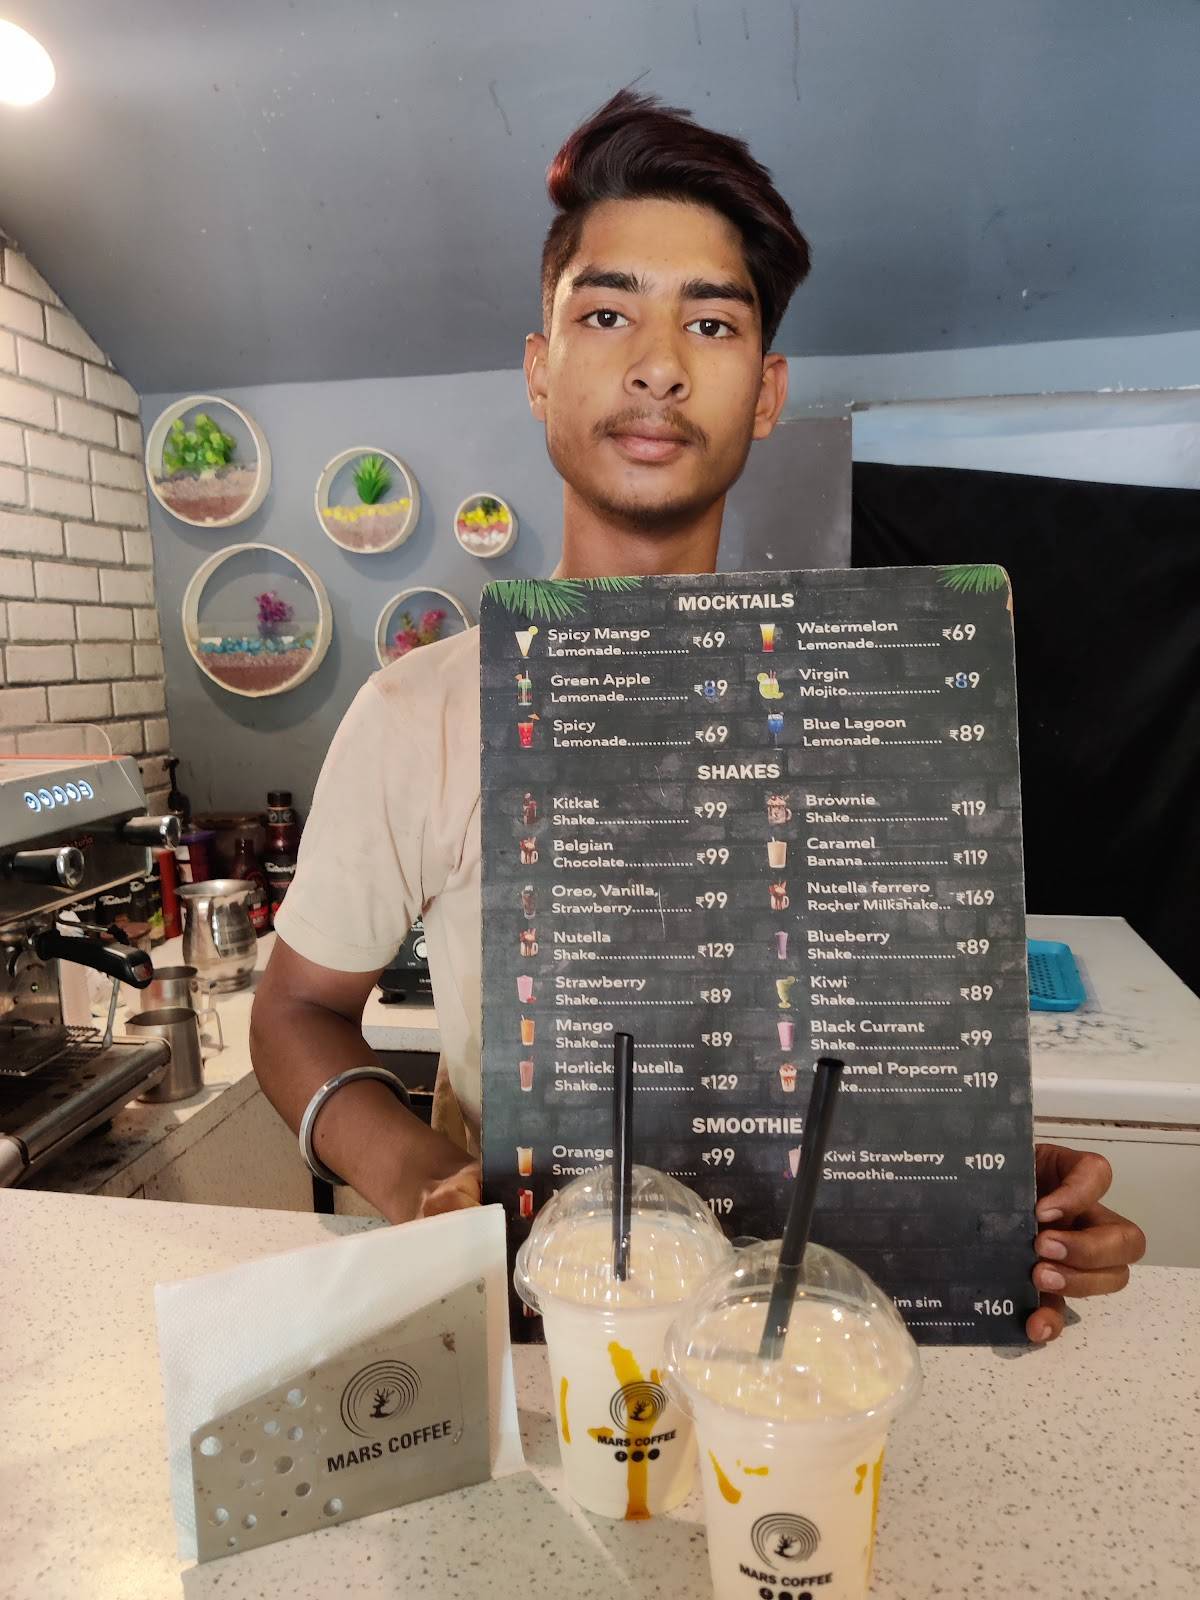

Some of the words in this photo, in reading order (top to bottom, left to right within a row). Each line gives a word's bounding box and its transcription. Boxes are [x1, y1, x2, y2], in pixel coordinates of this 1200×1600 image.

[678, 593, 795, 612] MOCKTAILS
[796, 620, 898, 634] Watermelon
[547, 629, 590, 643] Spicy
[594, 628, 651, 643] Mango
[551, 674, 600, 687] Green
[603, 673, 651, 688] Apple
[799, 668, 849, 683] Virgin
[553, 720, 596, 735] Spicy
[803, 718, 840, 730] Blue
[844, 717, 907, 732] Lagoon
[697, 764, 780, 780] SHAKES
[553, 798, 600, 809] Kitkat
[806, 794, 876, 807] Brownie
[553, 839, 614, 854] Belgian
[806, 837, 876, 850] Caramel
[807, 882, 867, 894] Nutella
[871, 882, 930, 894] ferrero
[807, 900, 860, 912] Rocher
[553, 931, 611, 943] Nutella
[807, 930, 890, 945] Blueberry
[555, 976, 646, 991] Strawberry
[810, 976, 847, 988] Kiwi
[555, 1019, 613, 1034] Mango
[810, 1020, 856, 1033] Black
[860, 1020, 925, 1033] Currant
[887, 1062, 958, 1078] Popcorn
[552, 1145, 614, 1162] Orange
[823, 1150, 855, 1162] Kiwi
[859, 1150, 944, 1166] Strawberry
[916, 1296, 942, 1308] sim
[598, 1435, 631, 1447] MARS
[635, 1429, 677, 1447] COFFEE
[327, 1442, 383, 1473] MARS
[388, 1420, 452, 1453] COFFEE
[739, 1563, 777, 1585] MARS
[781, 1572, 833, 1587] COFFEE
